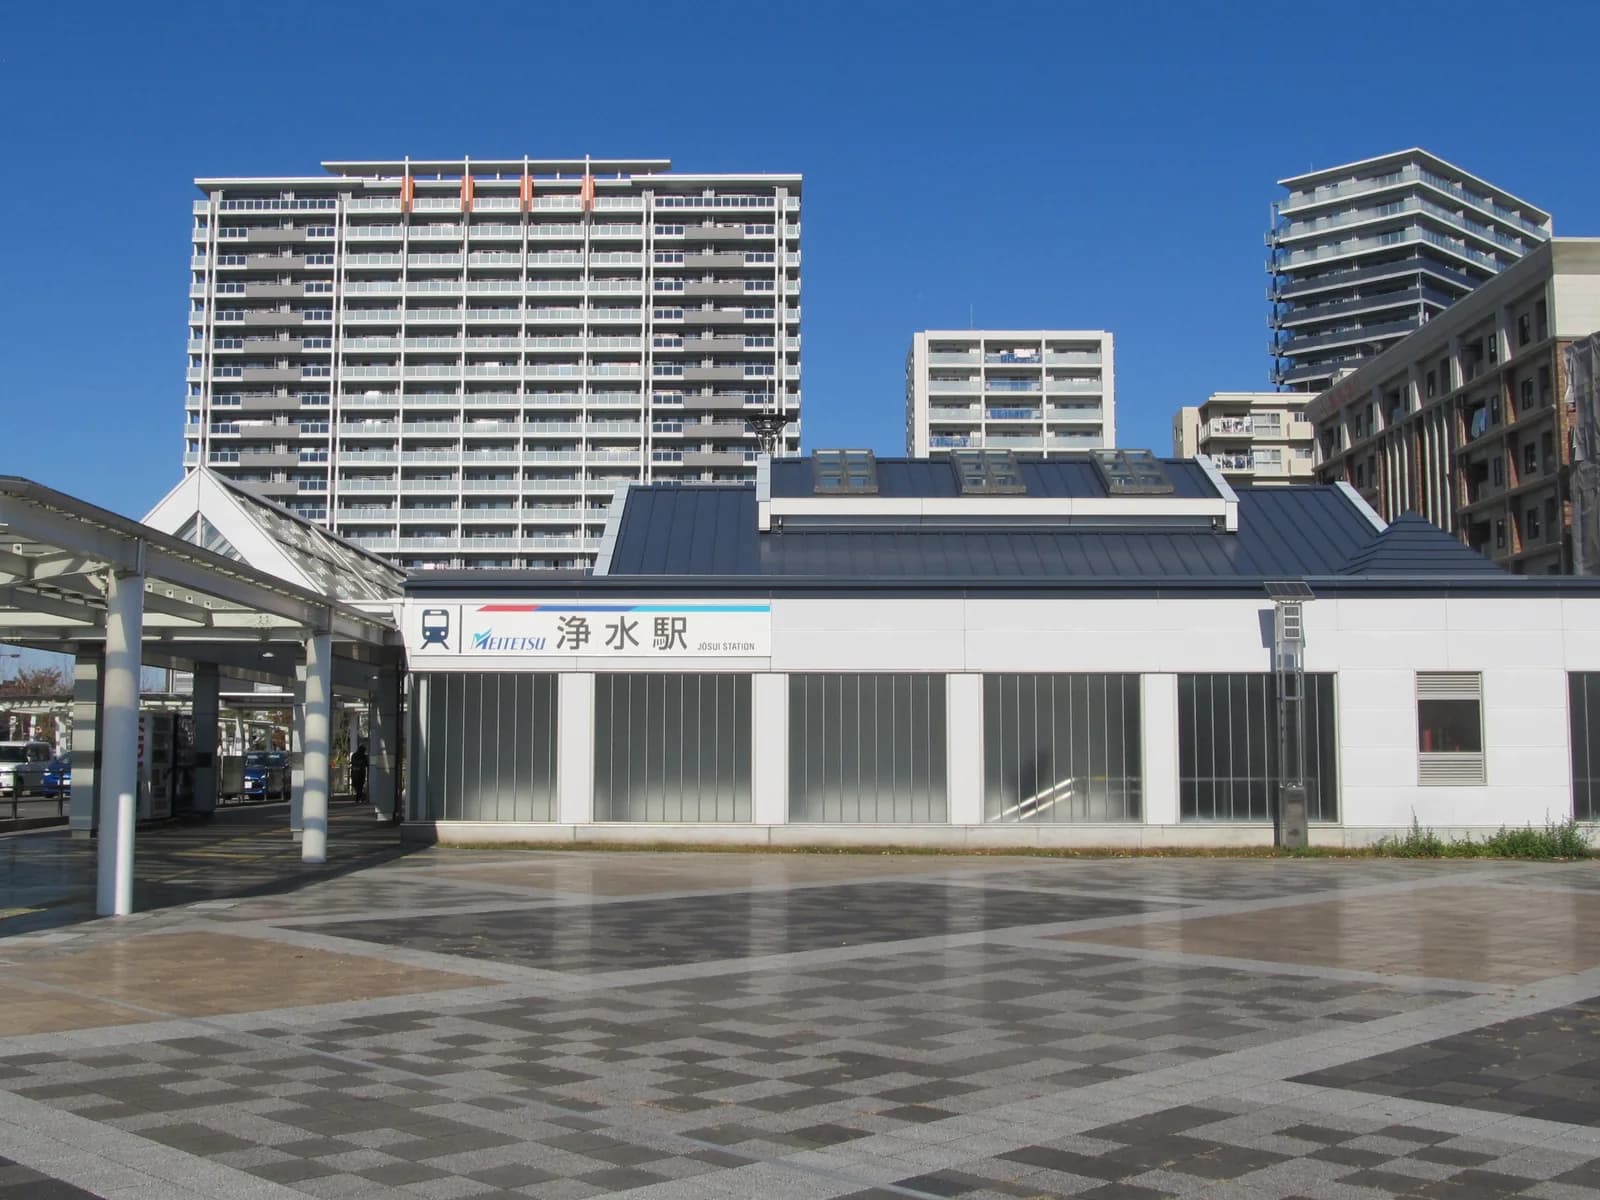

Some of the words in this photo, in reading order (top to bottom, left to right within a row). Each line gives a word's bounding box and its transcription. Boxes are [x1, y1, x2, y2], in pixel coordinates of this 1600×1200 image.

[471, 628, 546, 650] MEITETSU
[556, 615, 687, 650] 浄水駅
[697, 642, 720, 651] JOSUI
[722, 642, 755, 651] STATION
